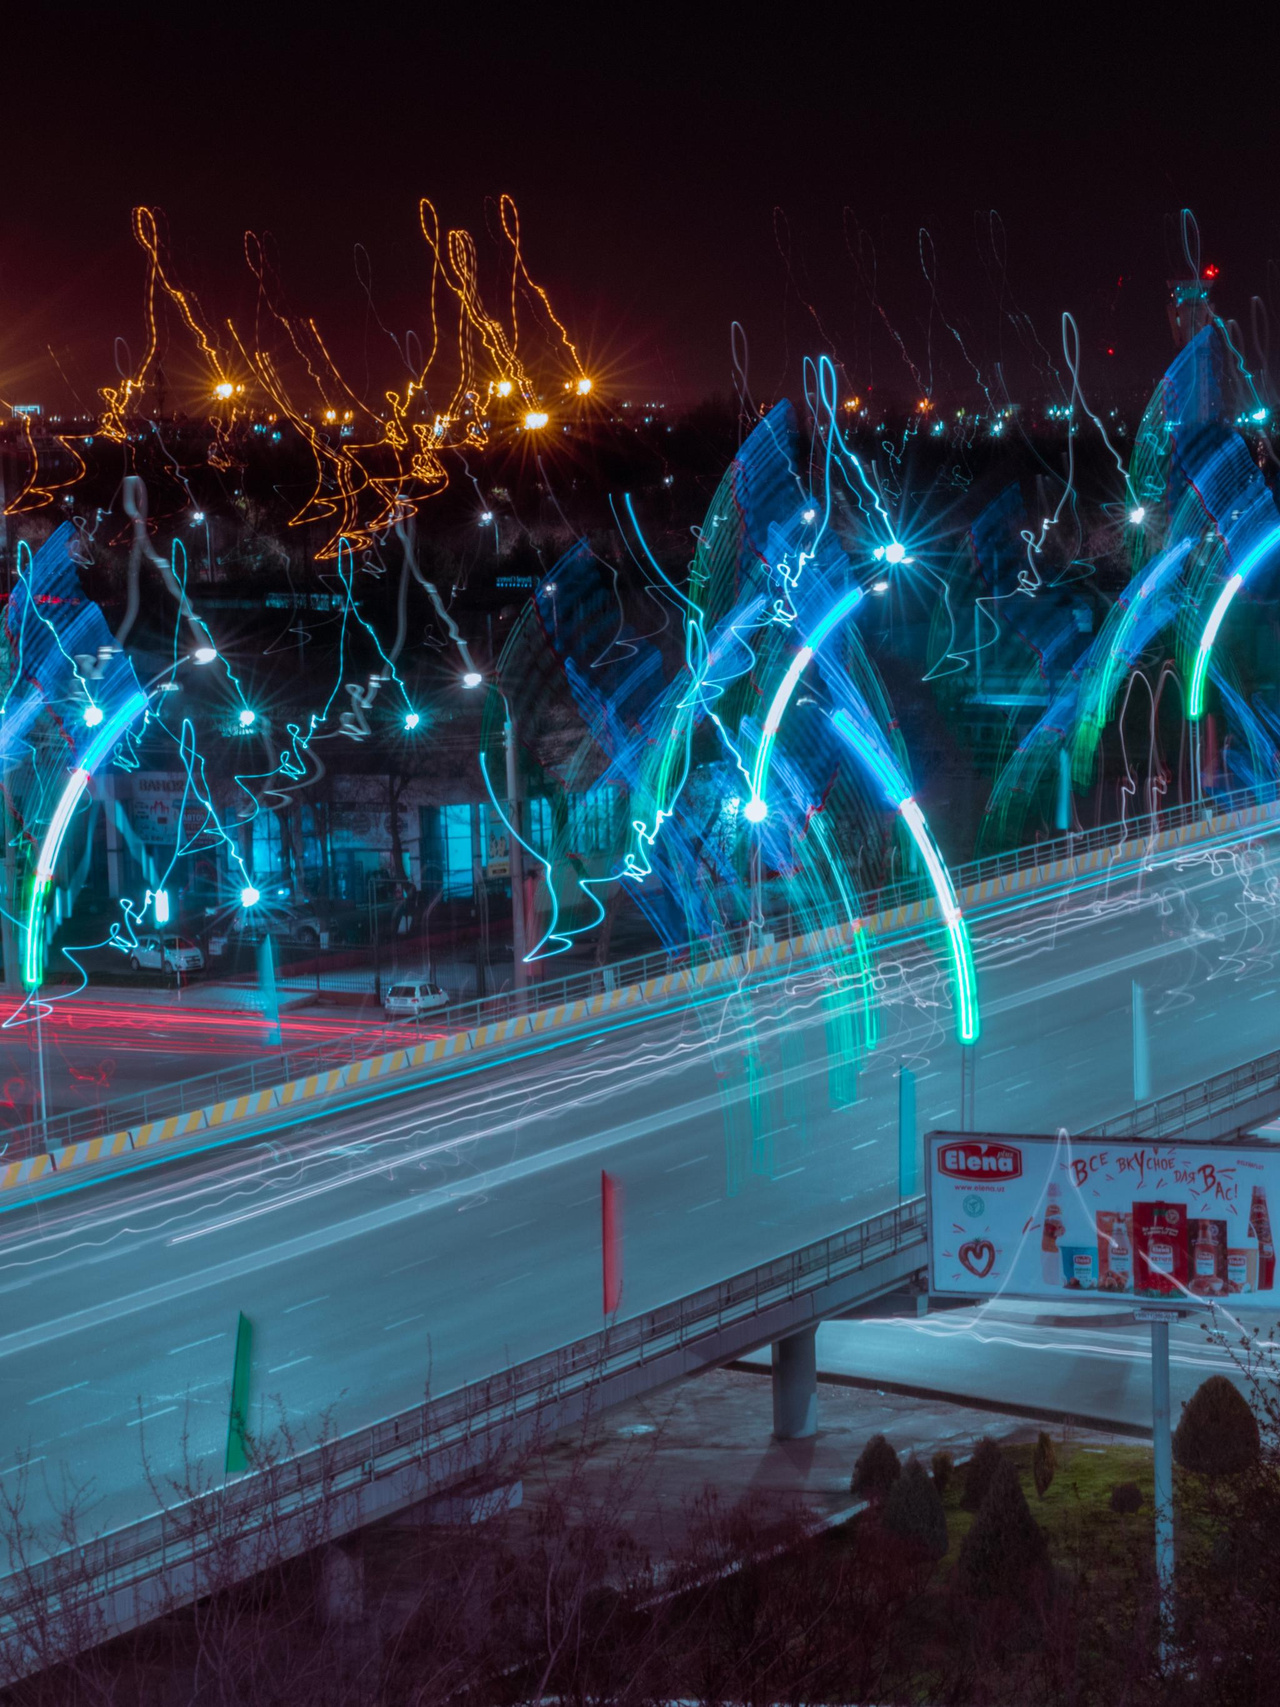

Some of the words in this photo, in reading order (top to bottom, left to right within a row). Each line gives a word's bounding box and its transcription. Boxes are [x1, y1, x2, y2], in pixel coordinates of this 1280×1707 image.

[945, 1148, 1013, 1172] Elena
[1072, 1152, 1108, 1187] ВСЕ
[1116, 1150, 1176, 1181] ВКУСНОЕ
[1174, 1170, 1196, 1184] ДЛЯ
[954, 1184, 1006, 1193] www.elena.uz
